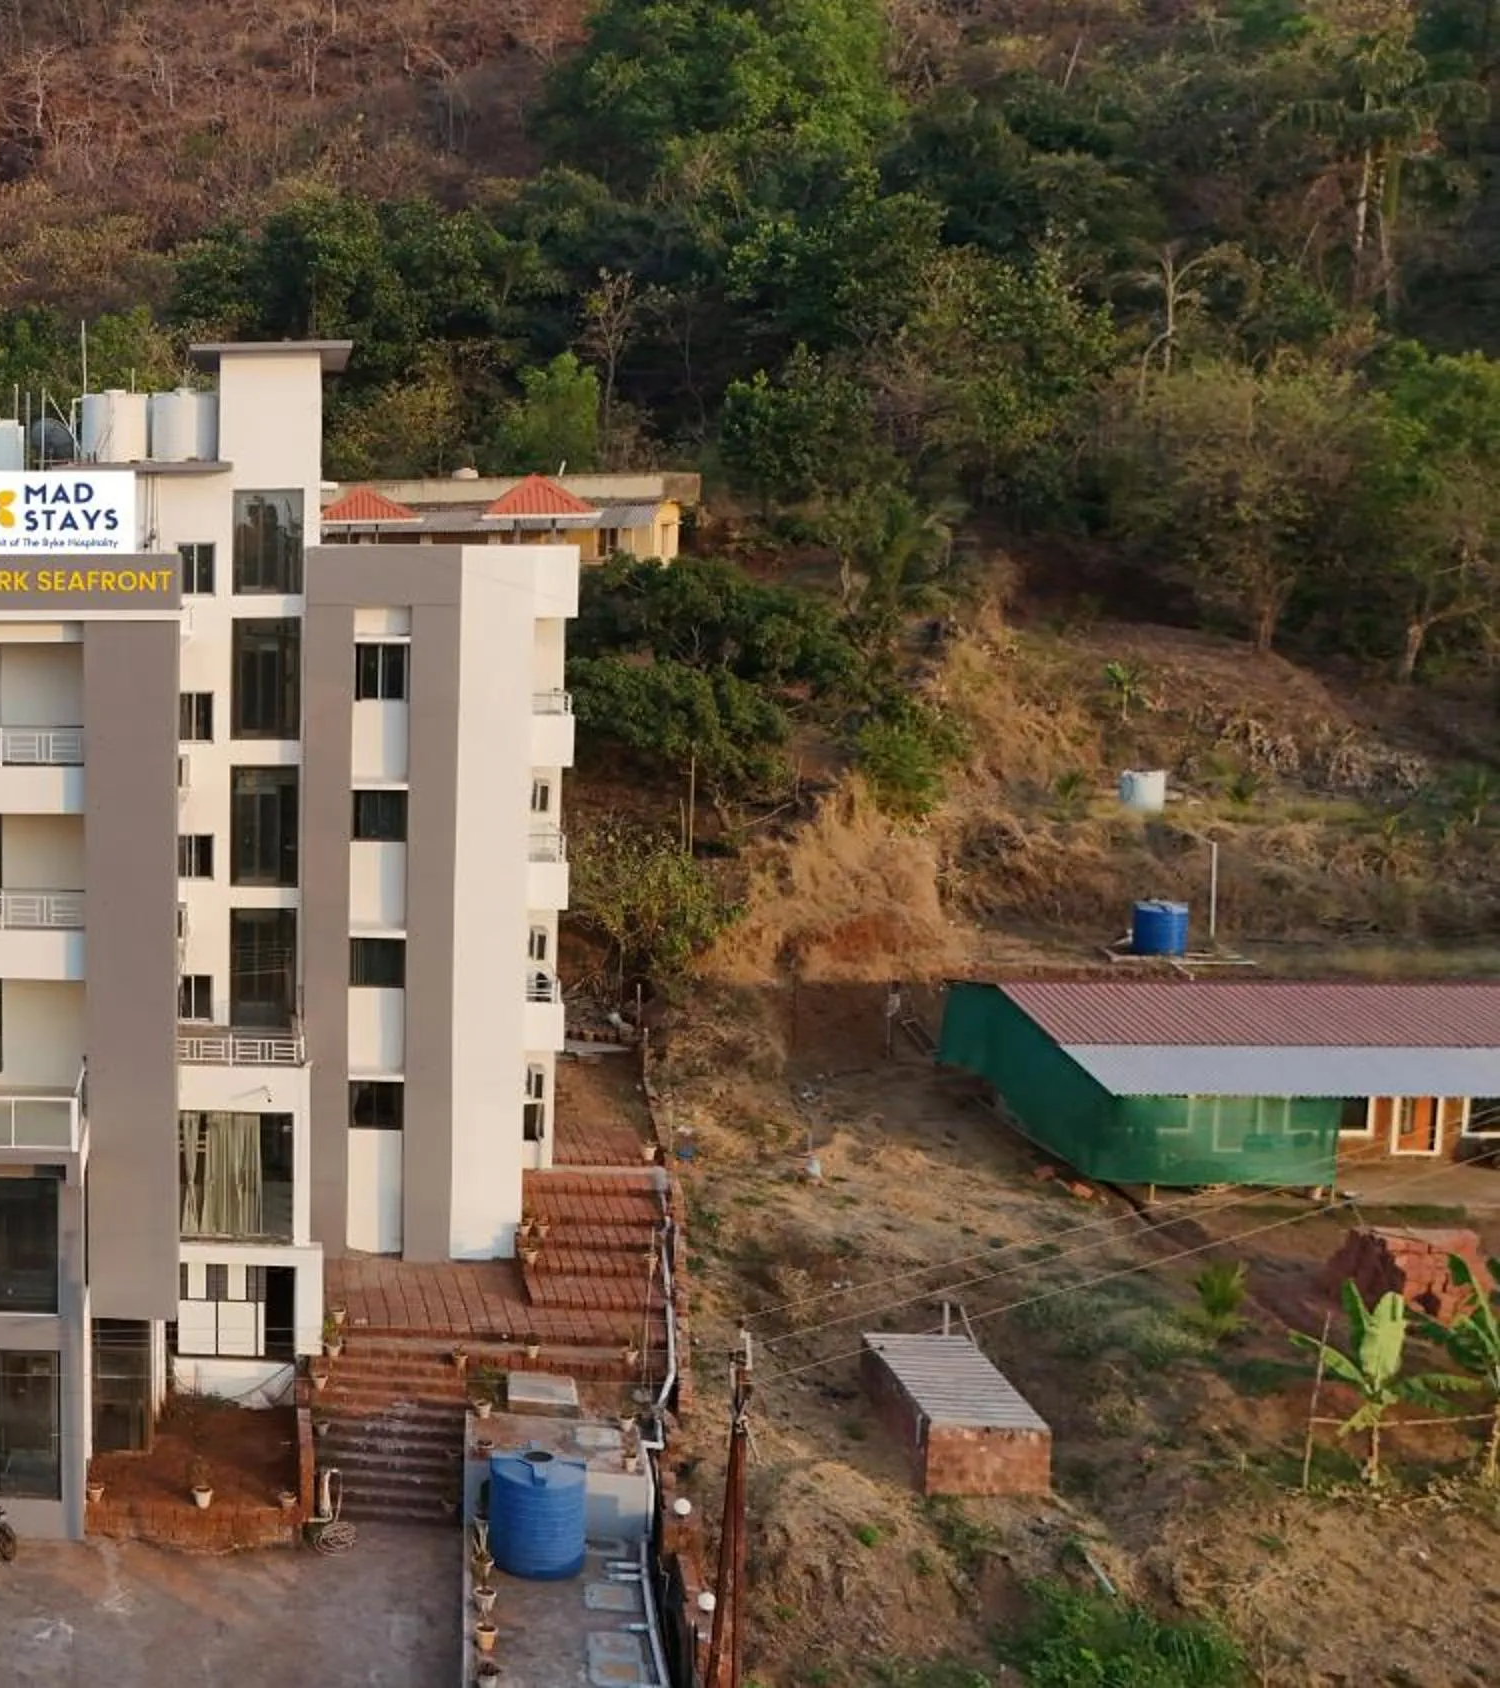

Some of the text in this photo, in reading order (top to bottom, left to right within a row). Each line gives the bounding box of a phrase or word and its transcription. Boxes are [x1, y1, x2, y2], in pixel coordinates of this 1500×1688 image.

[24, 482, 94, 505] MAD
[24, 508, 119, 531] STAYS
[9, 537, 20, 547] of
[22, 537, 40, 547] The
[67, 537, 119, 549] Hospitality
[36, 570, 173, 593] SEAFRONT
